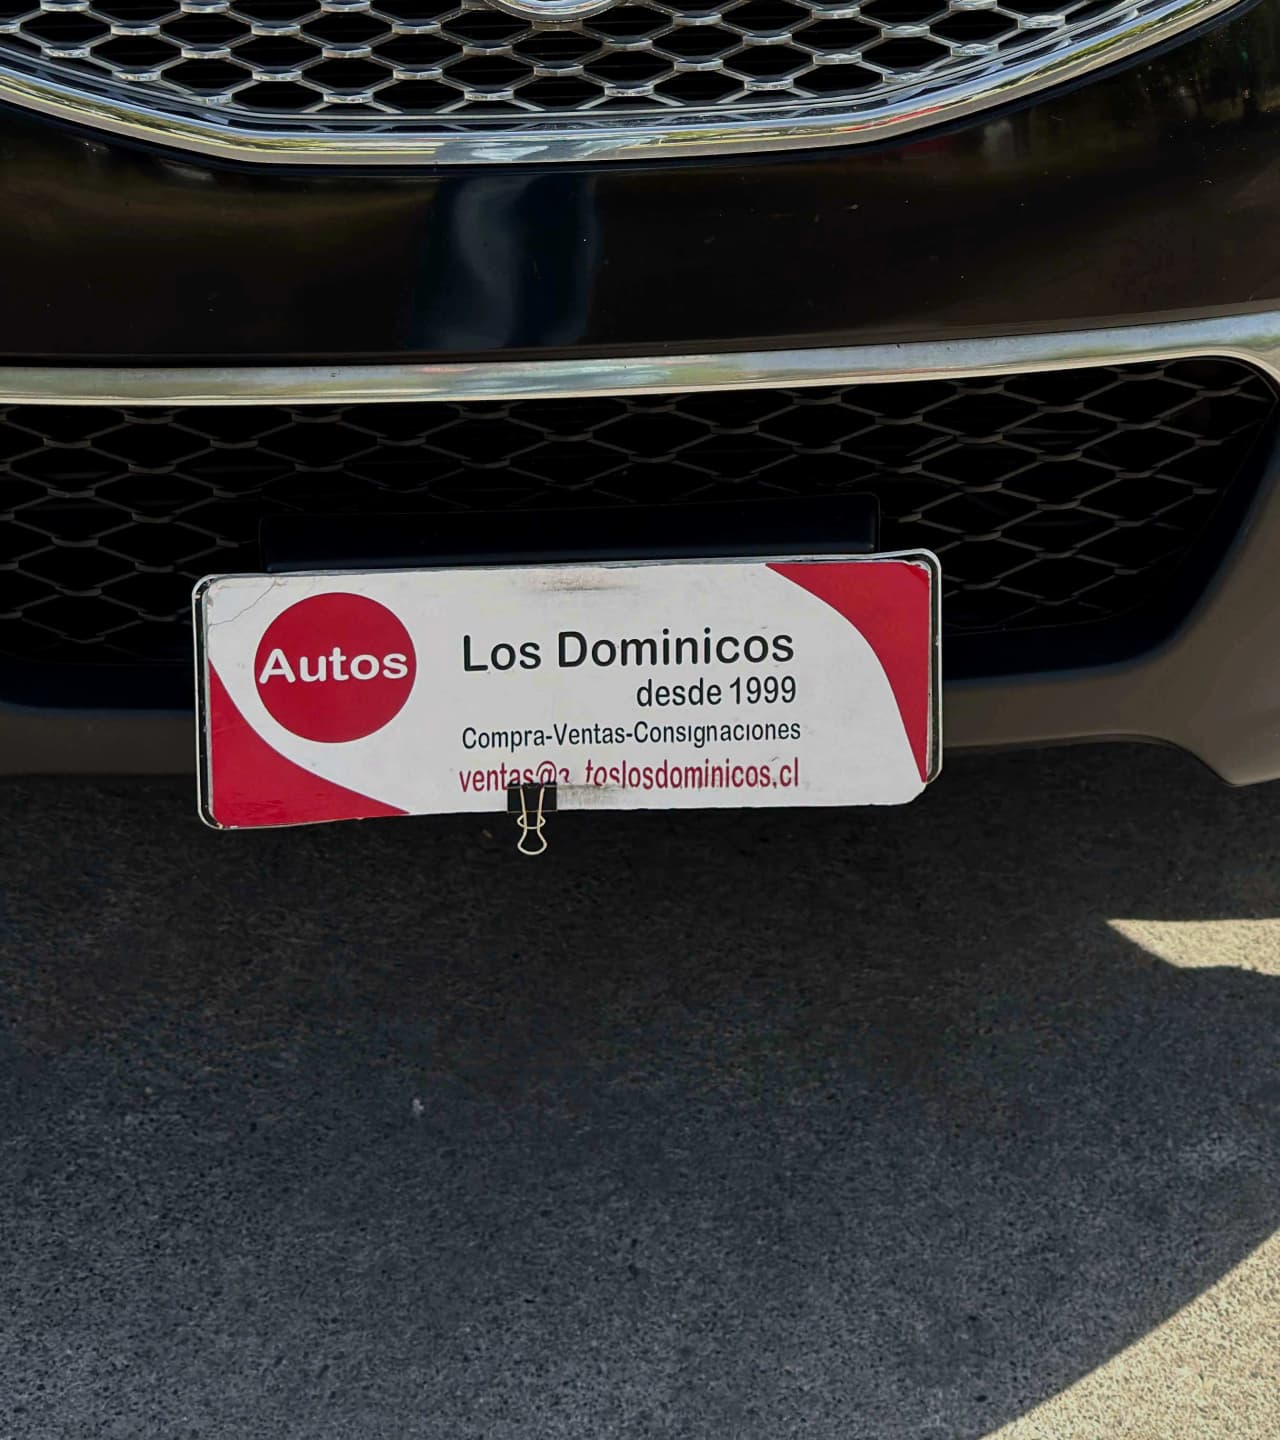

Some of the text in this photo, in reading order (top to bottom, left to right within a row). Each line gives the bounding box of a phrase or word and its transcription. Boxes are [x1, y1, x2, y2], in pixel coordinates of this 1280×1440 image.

[258, 646, 410, 685] Autos
[463, 627, 795, 672] Los Dominicos
[636, 675, 797, 707] desde 1999
[462, 721, 801, 752] Compra-Ventas-Consignaciones
